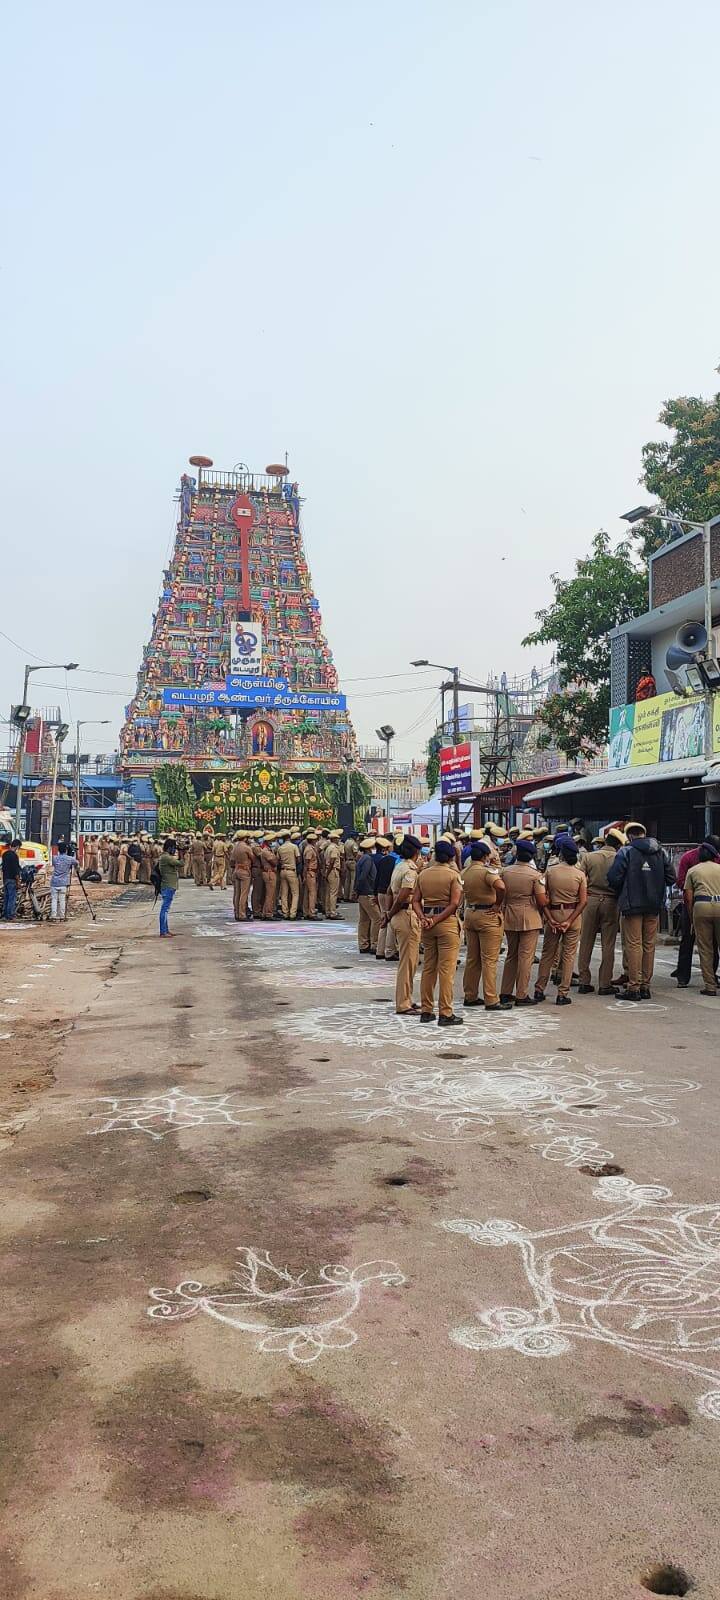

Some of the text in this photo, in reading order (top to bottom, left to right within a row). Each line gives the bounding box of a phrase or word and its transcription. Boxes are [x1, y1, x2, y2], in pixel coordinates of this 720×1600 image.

[230, 678, 286, 691] அருள்மிகு
[217, 692, 271, 704] ஆண்டவர்
[274, 693, 340, 706] திருக்கோயில்
